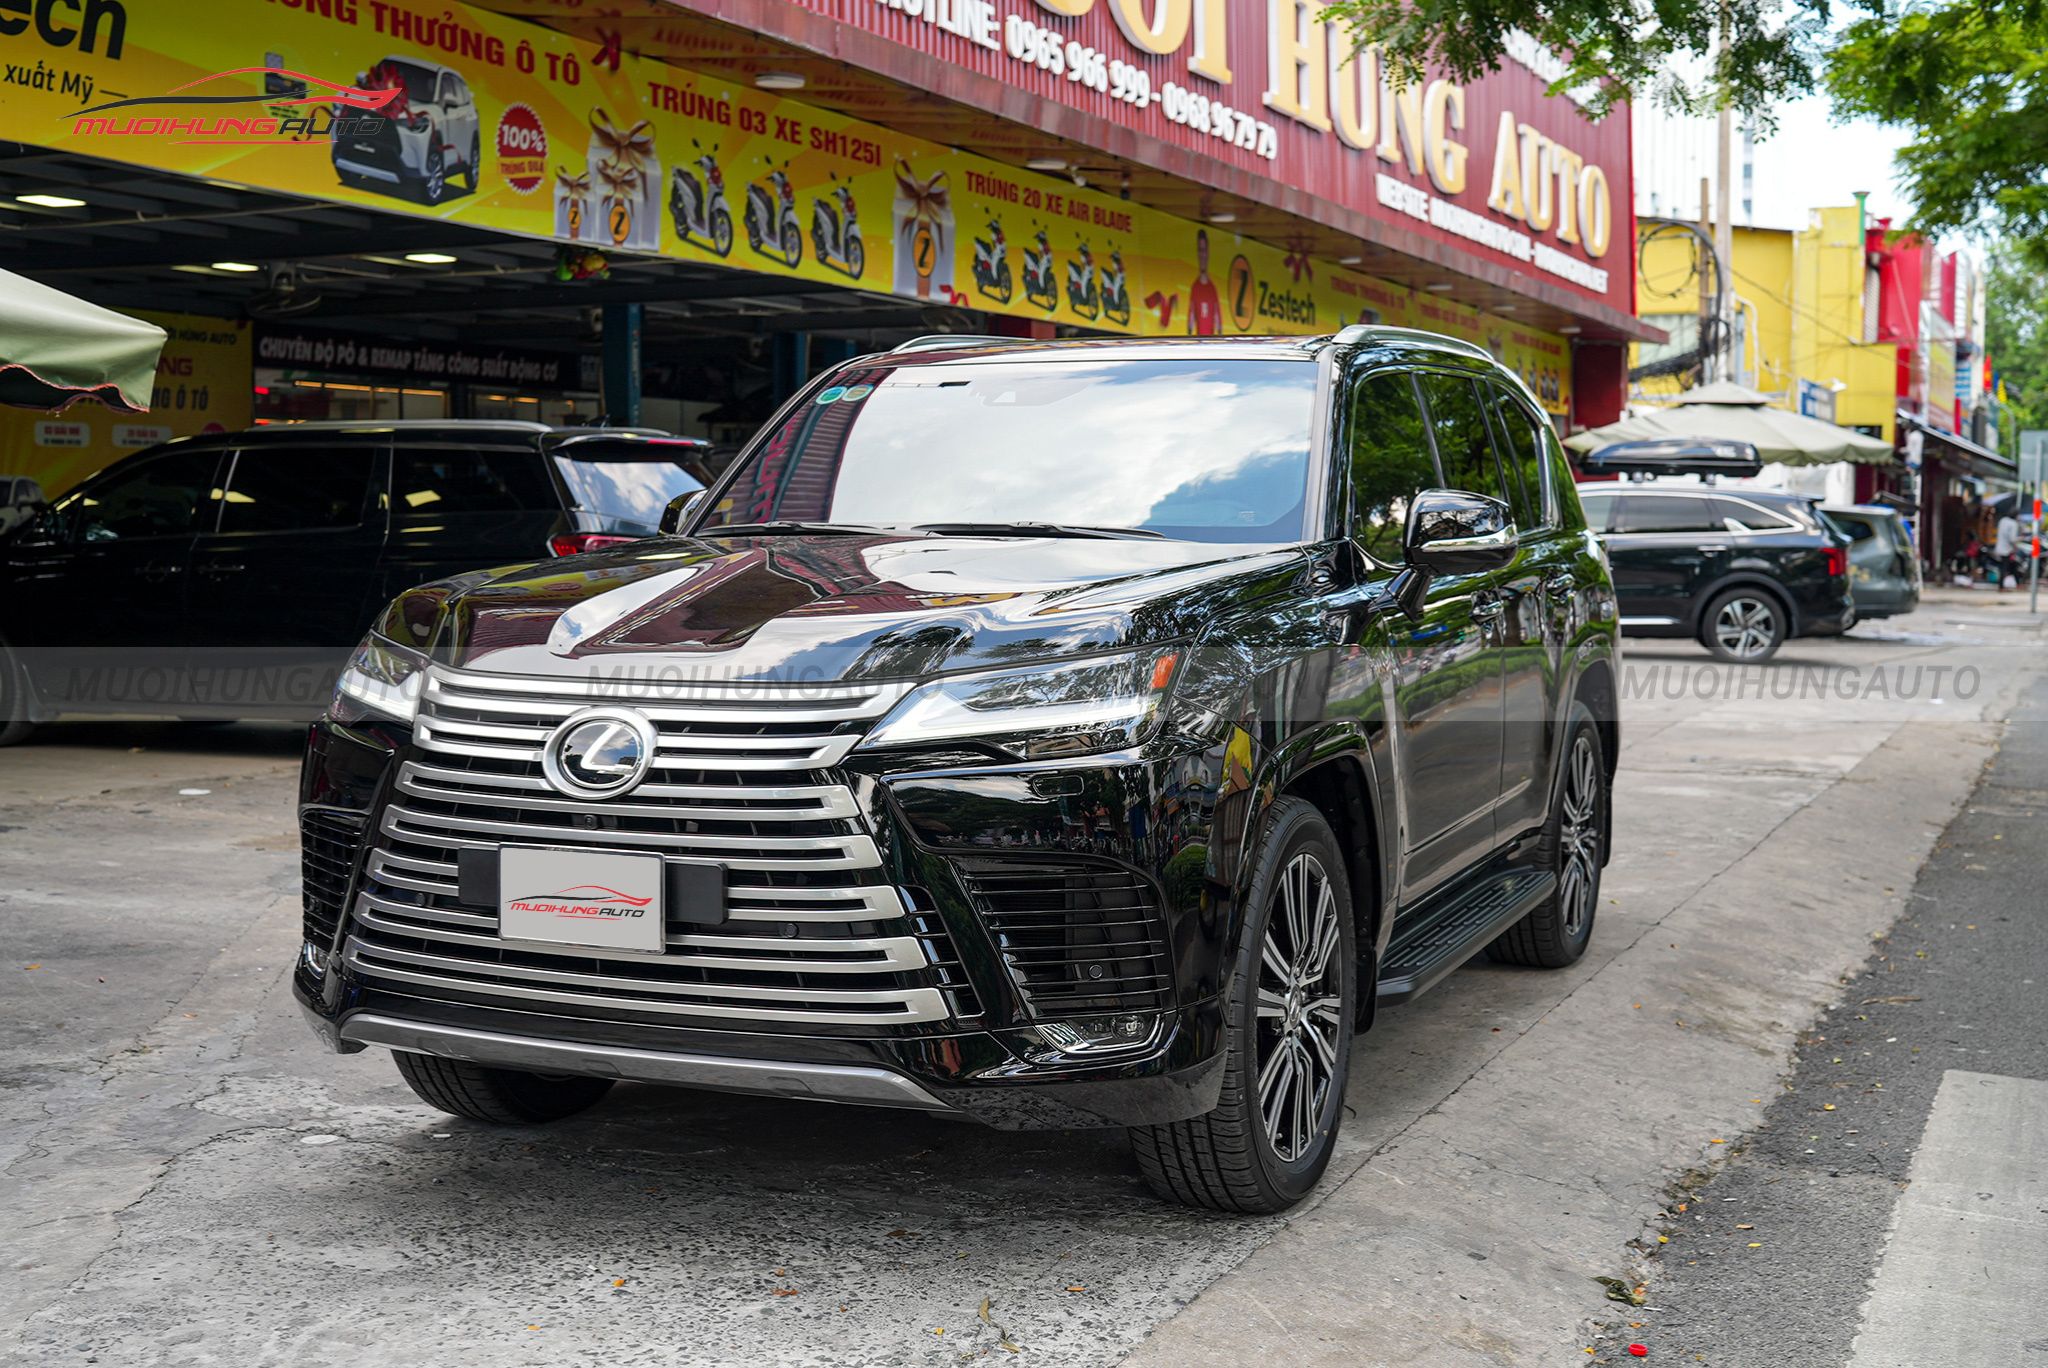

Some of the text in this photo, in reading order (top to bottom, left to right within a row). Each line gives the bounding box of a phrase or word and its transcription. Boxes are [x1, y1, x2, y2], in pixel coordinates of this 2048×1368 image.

[370, 3, 505, 66] THƯỞNG
[515, 40, 535, 74] Ô
[545, 53, 581, 86] TÔ
[1005, 14, 1065, 75] 0965
[1065, 41, 1108, 93] 966
[4, 60, 94, 105] xuất Mỹ
[502, 124, 544, 152] 100%
[648, 81, 881, 167] TRÚNG 03 XE SH125I
[965, 170, 1133, 234] TRÚNG 20 XE AIR BLADE
[1487, 111, 1611, 257] AUTO
[1258, 281, 1316, 326] Zestech
